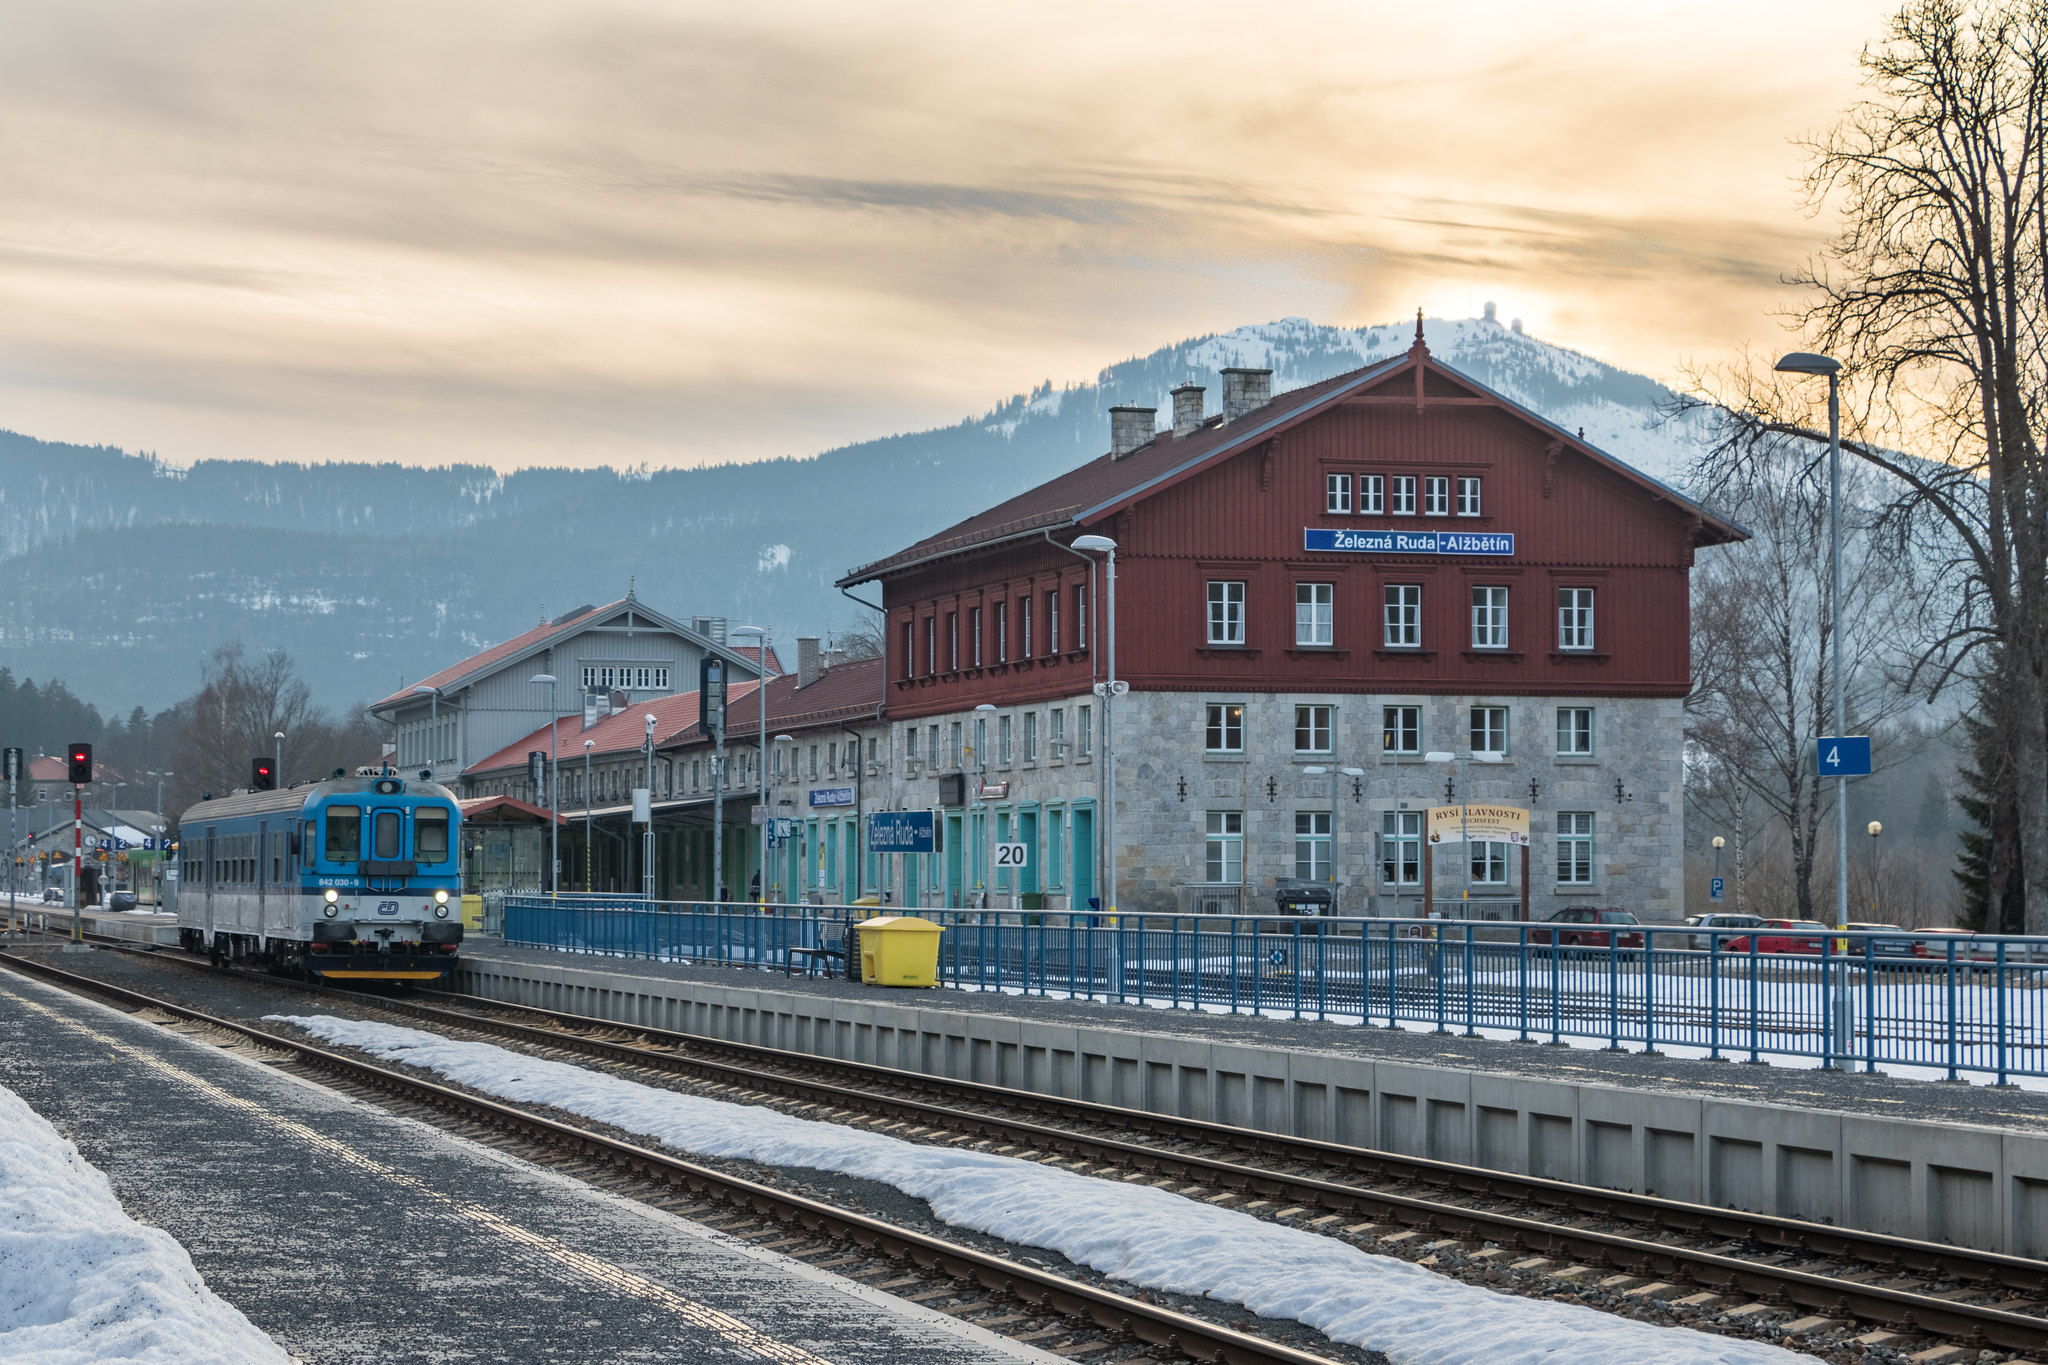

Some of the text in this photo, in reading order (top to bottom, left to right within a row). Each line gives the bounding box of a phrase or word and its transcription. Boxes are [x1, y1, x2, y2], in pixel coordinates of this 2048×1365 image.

[1334, 530, 1393, 550] Železná
[1397, 535, 1436, 550] Ruda
[1826, 745, 1841, 767] 4
[101, 839, 108, 848] 4
[118, 840, 126, 848] 2
[144, 837, 152, 848] 4
[998, 845, 1024, 865] 20
[318, 878, 333, 886] 842
[1713, 880, 1722, 892] P
